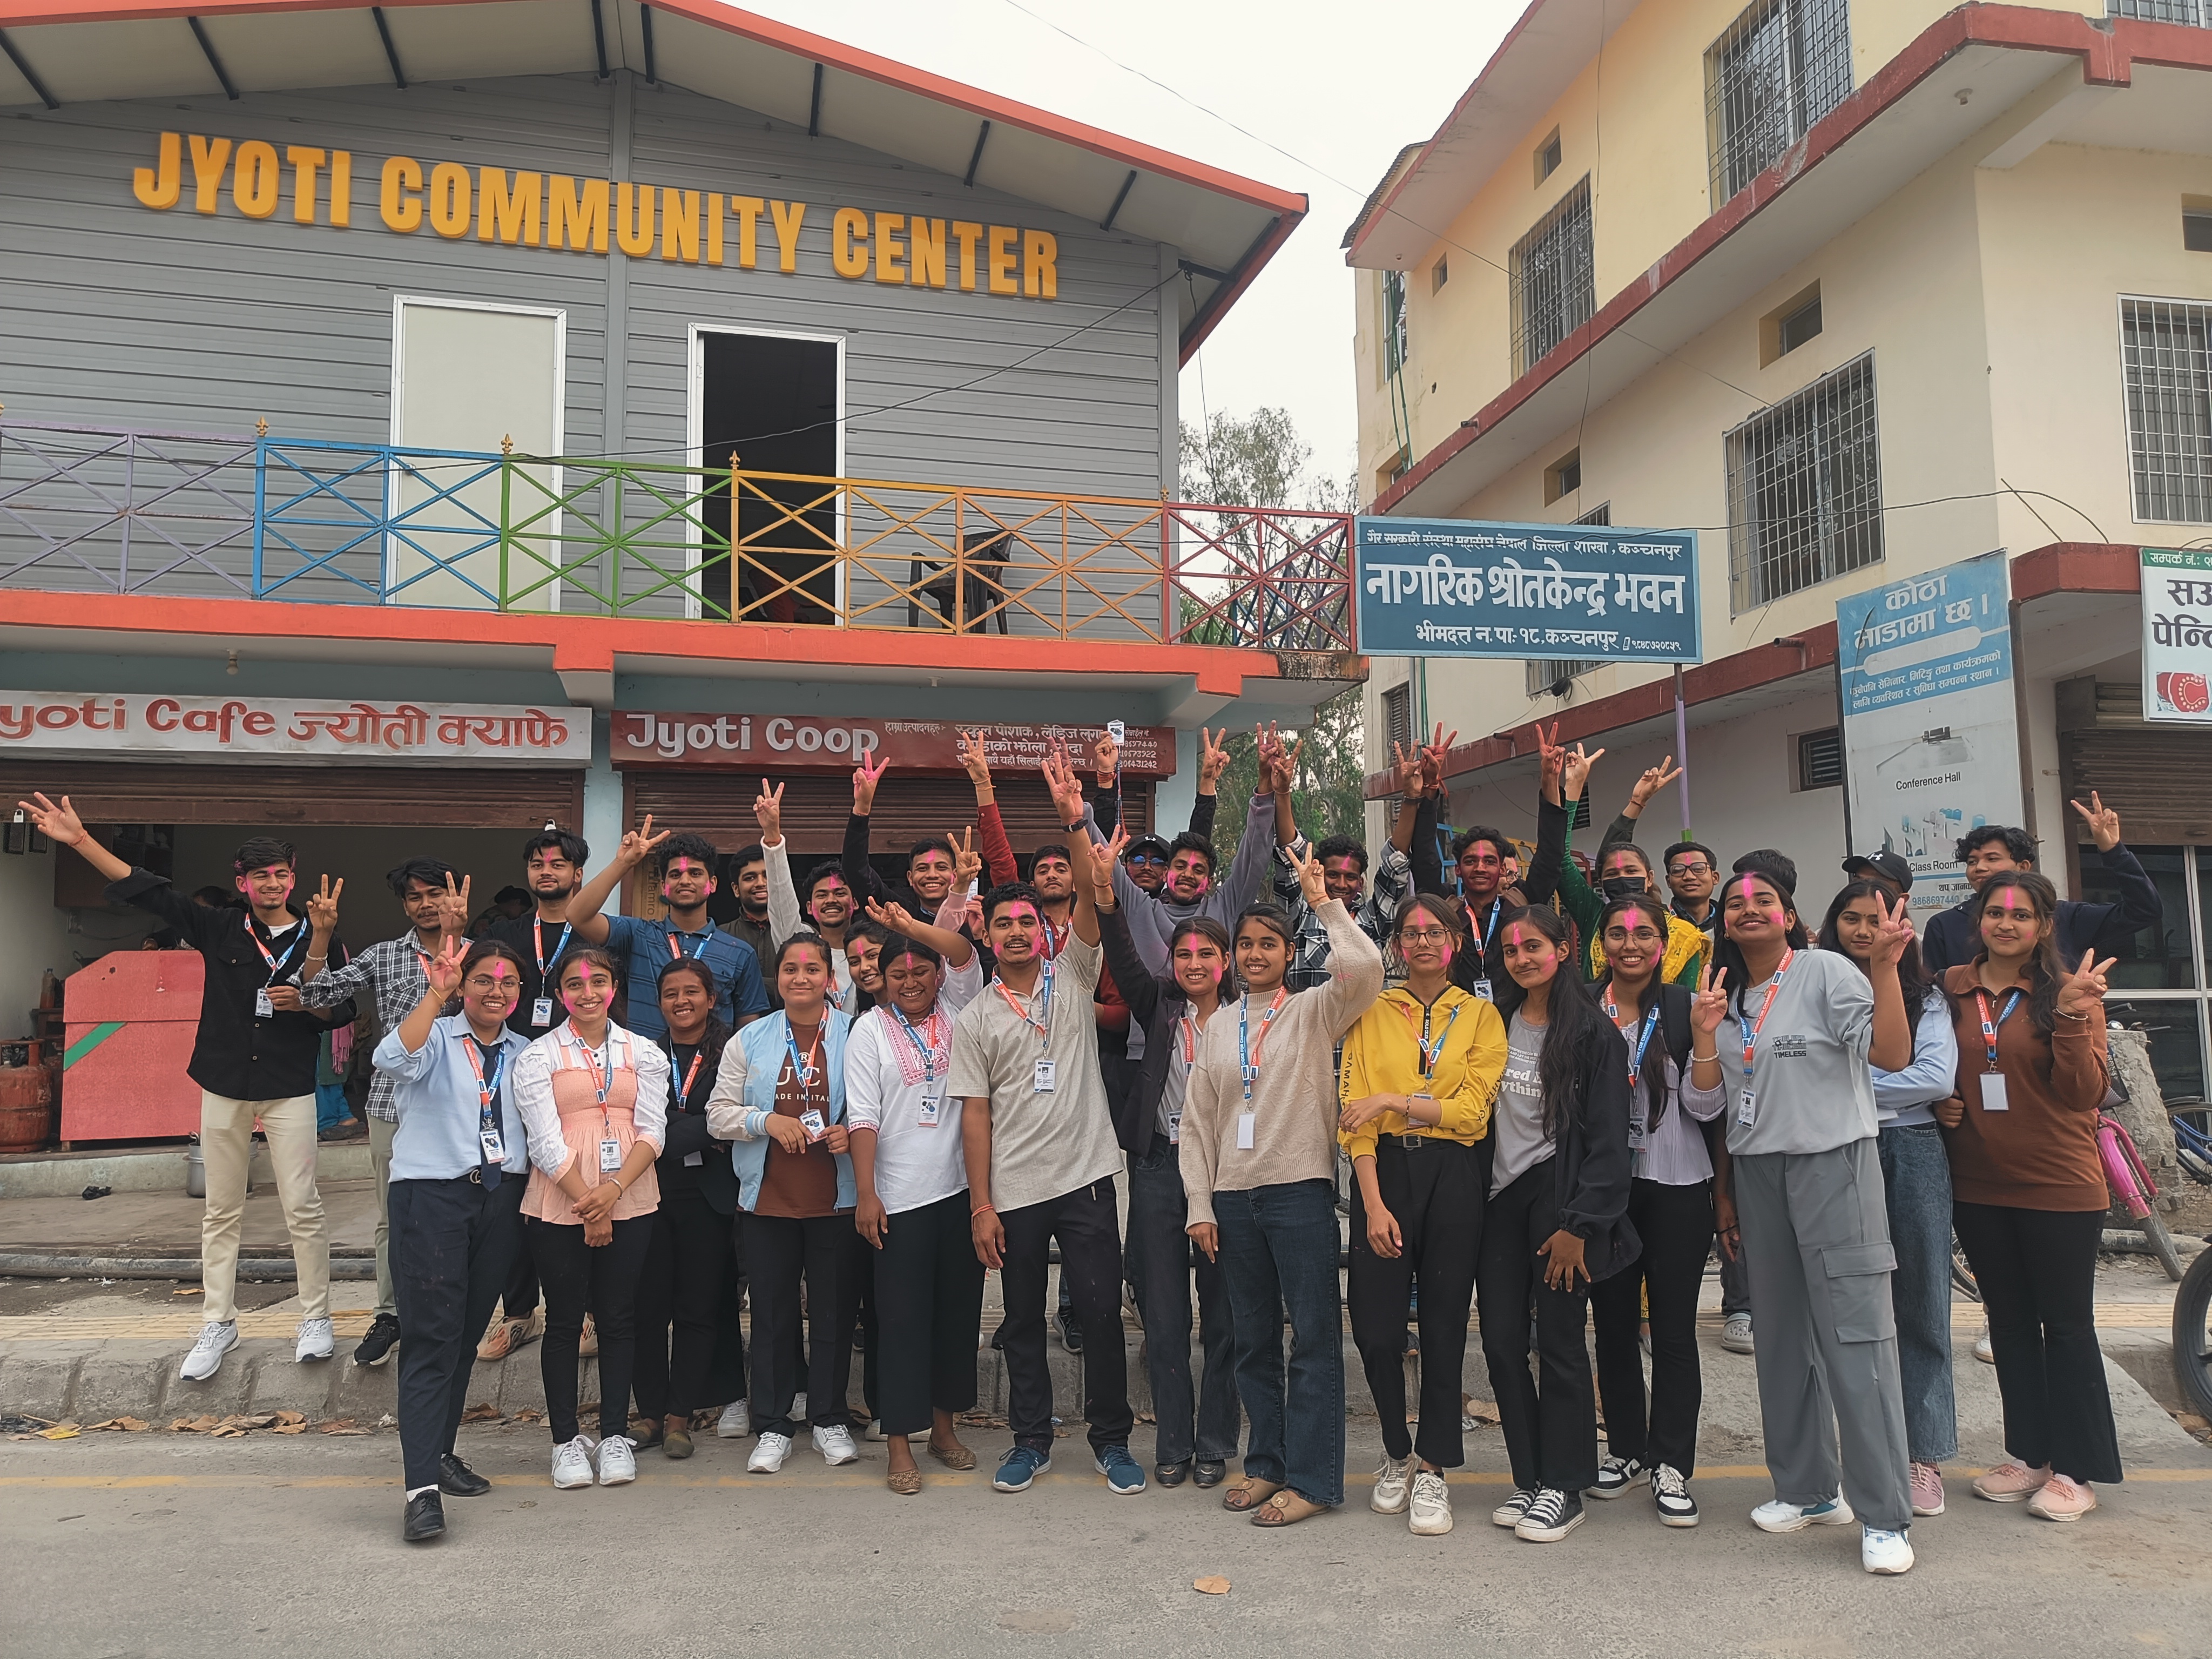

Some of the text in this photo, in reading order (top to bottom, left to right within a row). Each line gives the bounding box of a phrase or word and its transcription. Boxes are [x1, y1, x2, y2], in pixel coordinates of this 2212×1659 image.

[133, 132, 1059, 298] JYOTI COMMUNITY CENTER
[1367, 529, 1382, 544] गैर
[1384, 531, 1420, 547] सरकारी
[1617, 542, 1682, 561] कञ्चनपुर
[2150, 551, 2182, 564] सम्पर्क
[1366, 554, 1483, 606] नागरिक
[1614, 573, 1686, 614] भवन
[1885, 575, 1947, 610] कोठा
[1945, 598, 1973, 624] छ
[1415, 619, 1472, 645] भीमदत्त
[1545, 629, 1619, 651] कञ्चनपुर
[1935, 664, 1951, 675] तथा
[0, 698, 276, 744] yoti Cafe
[287, 704, 569, 750] ज्योती क्याफे
[626, 714, 879, 761] Jyoti Coop
[1896, 771, 1960, 790] Conference Hall
[1909, 860, 1958, 872] Class Room
[1774, 1050, 1806, 1058] TIMELESS
[1501, 1081, 1542, 1097] ythin
